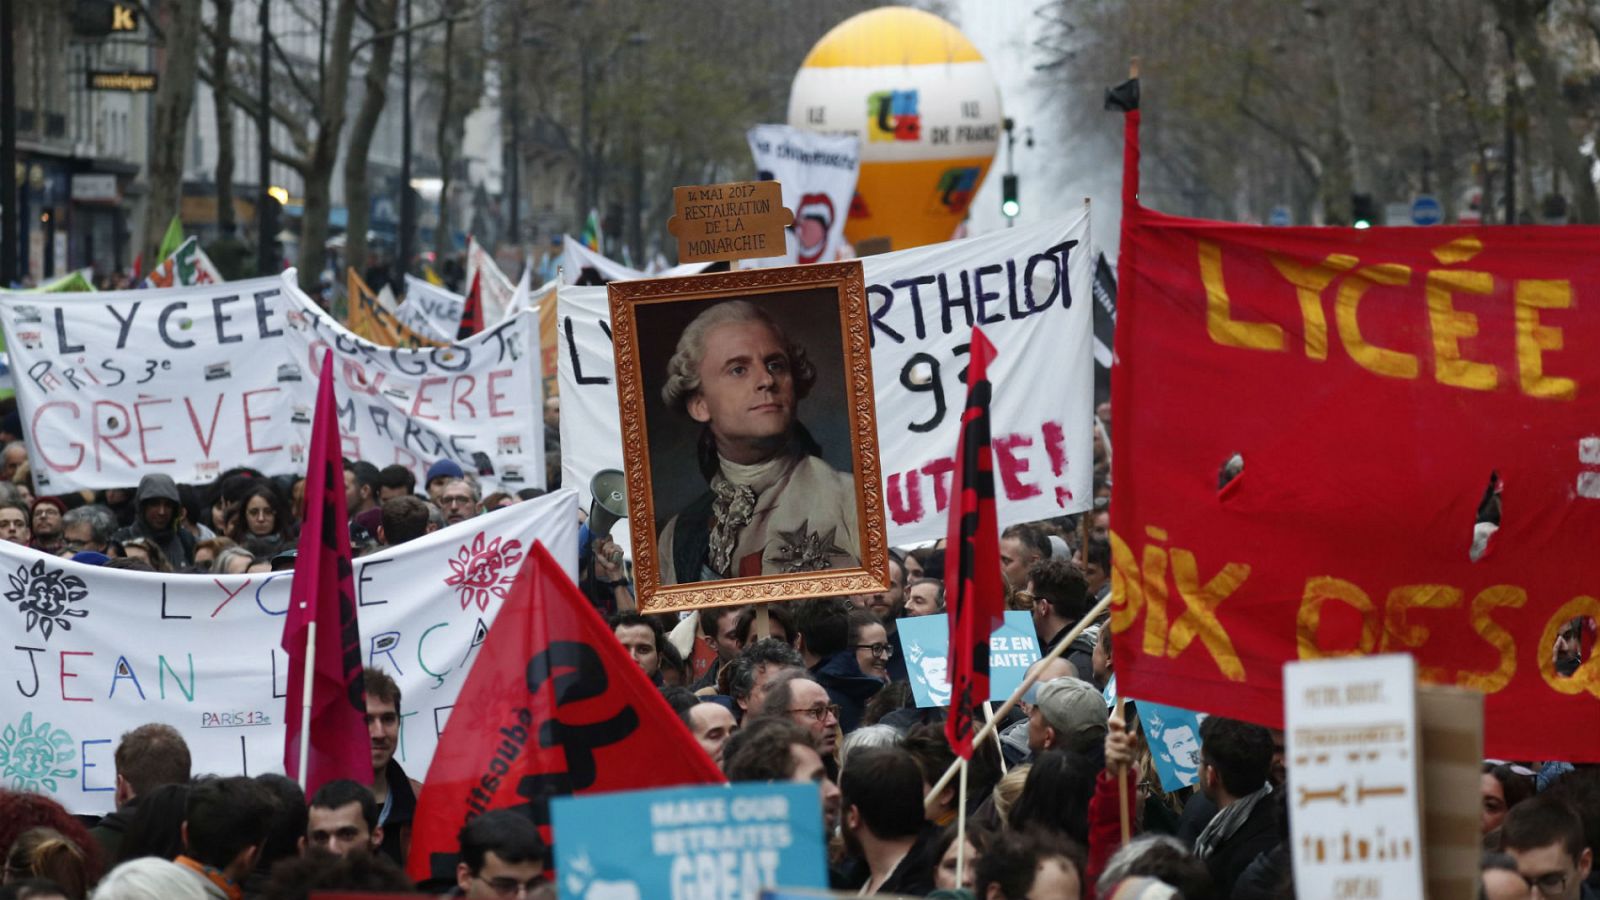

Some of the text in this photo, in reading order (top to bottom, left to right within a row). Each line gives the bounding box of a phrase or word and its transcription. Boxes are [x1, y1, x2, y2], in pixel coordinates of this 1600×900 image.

[956, 122, 999, 142] FRANC
[699, 188, 723, 200] MAI
[728, 185, 756, 199] 2017
[684, 199, 771, 220] RESTAURATION
[705, 218, 745, 234] DE LA
[688, 234, 767, 256] MONARCHIE
[54, 288, 284, 354] LYCEE
[1197, 235, 1578, 400] LYCÉE
[989, 636, 1034, 651] EZ EN
[14, 645, 195, 702] JEAN
[651, 795, 789, 826] MAKE OUR
[652, 824, 793, 855] RETRAITES
